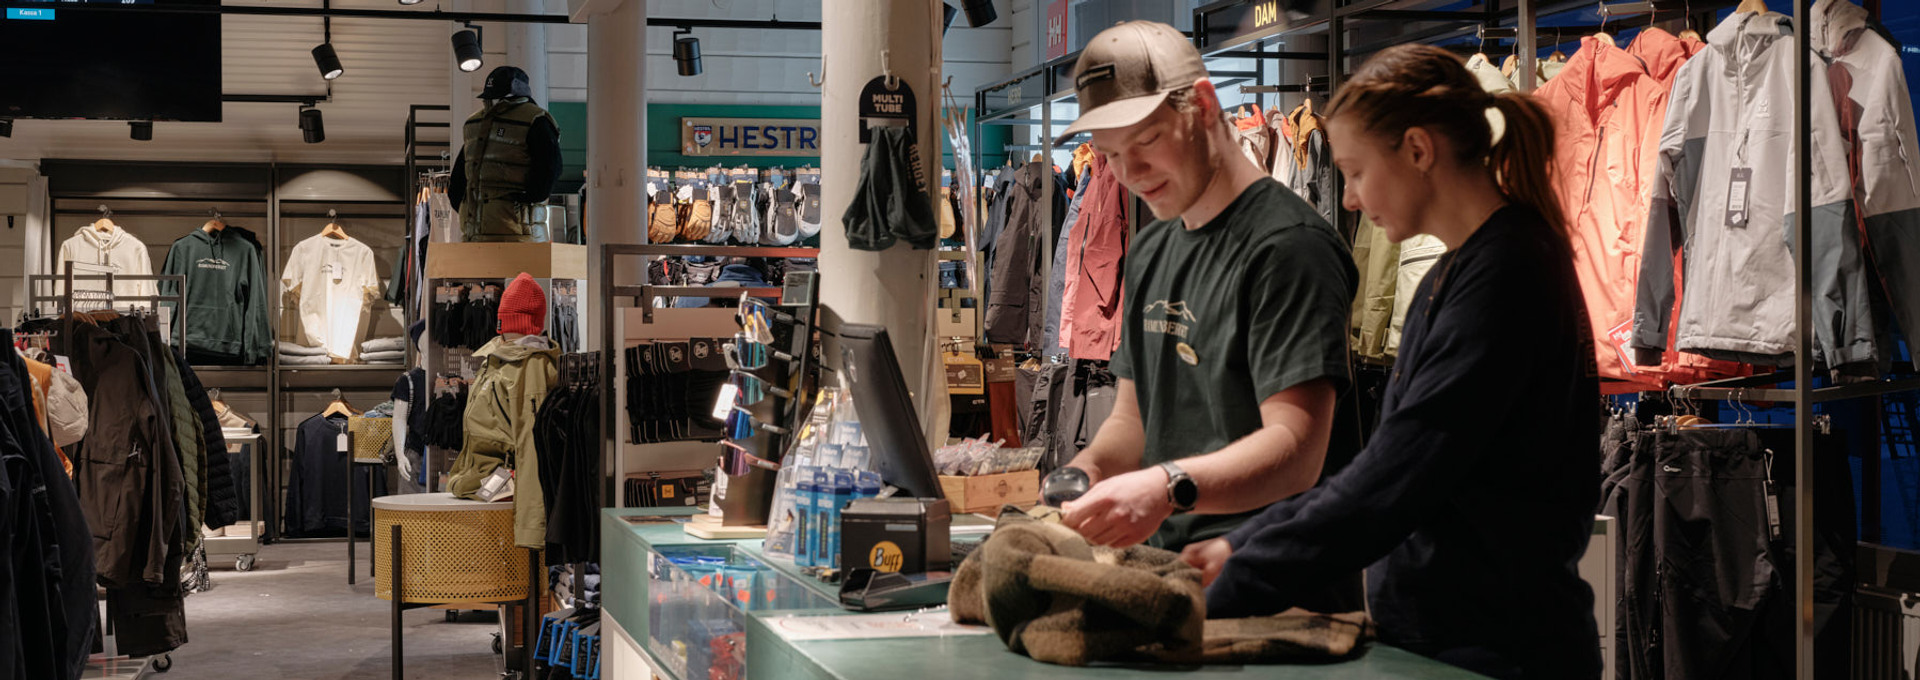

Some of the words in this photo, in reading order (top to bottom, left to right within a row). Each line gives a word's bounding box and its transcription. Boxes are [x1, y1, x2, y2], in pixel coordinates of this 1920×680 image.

[1255, 0, 1277, 28] DAM
[872, 94, 904, 103] MULTI
[874, 104, 902, 113] TUBE
[719, 125, 818, 149] HESTR
[873, 547, 900, 572] Buff
